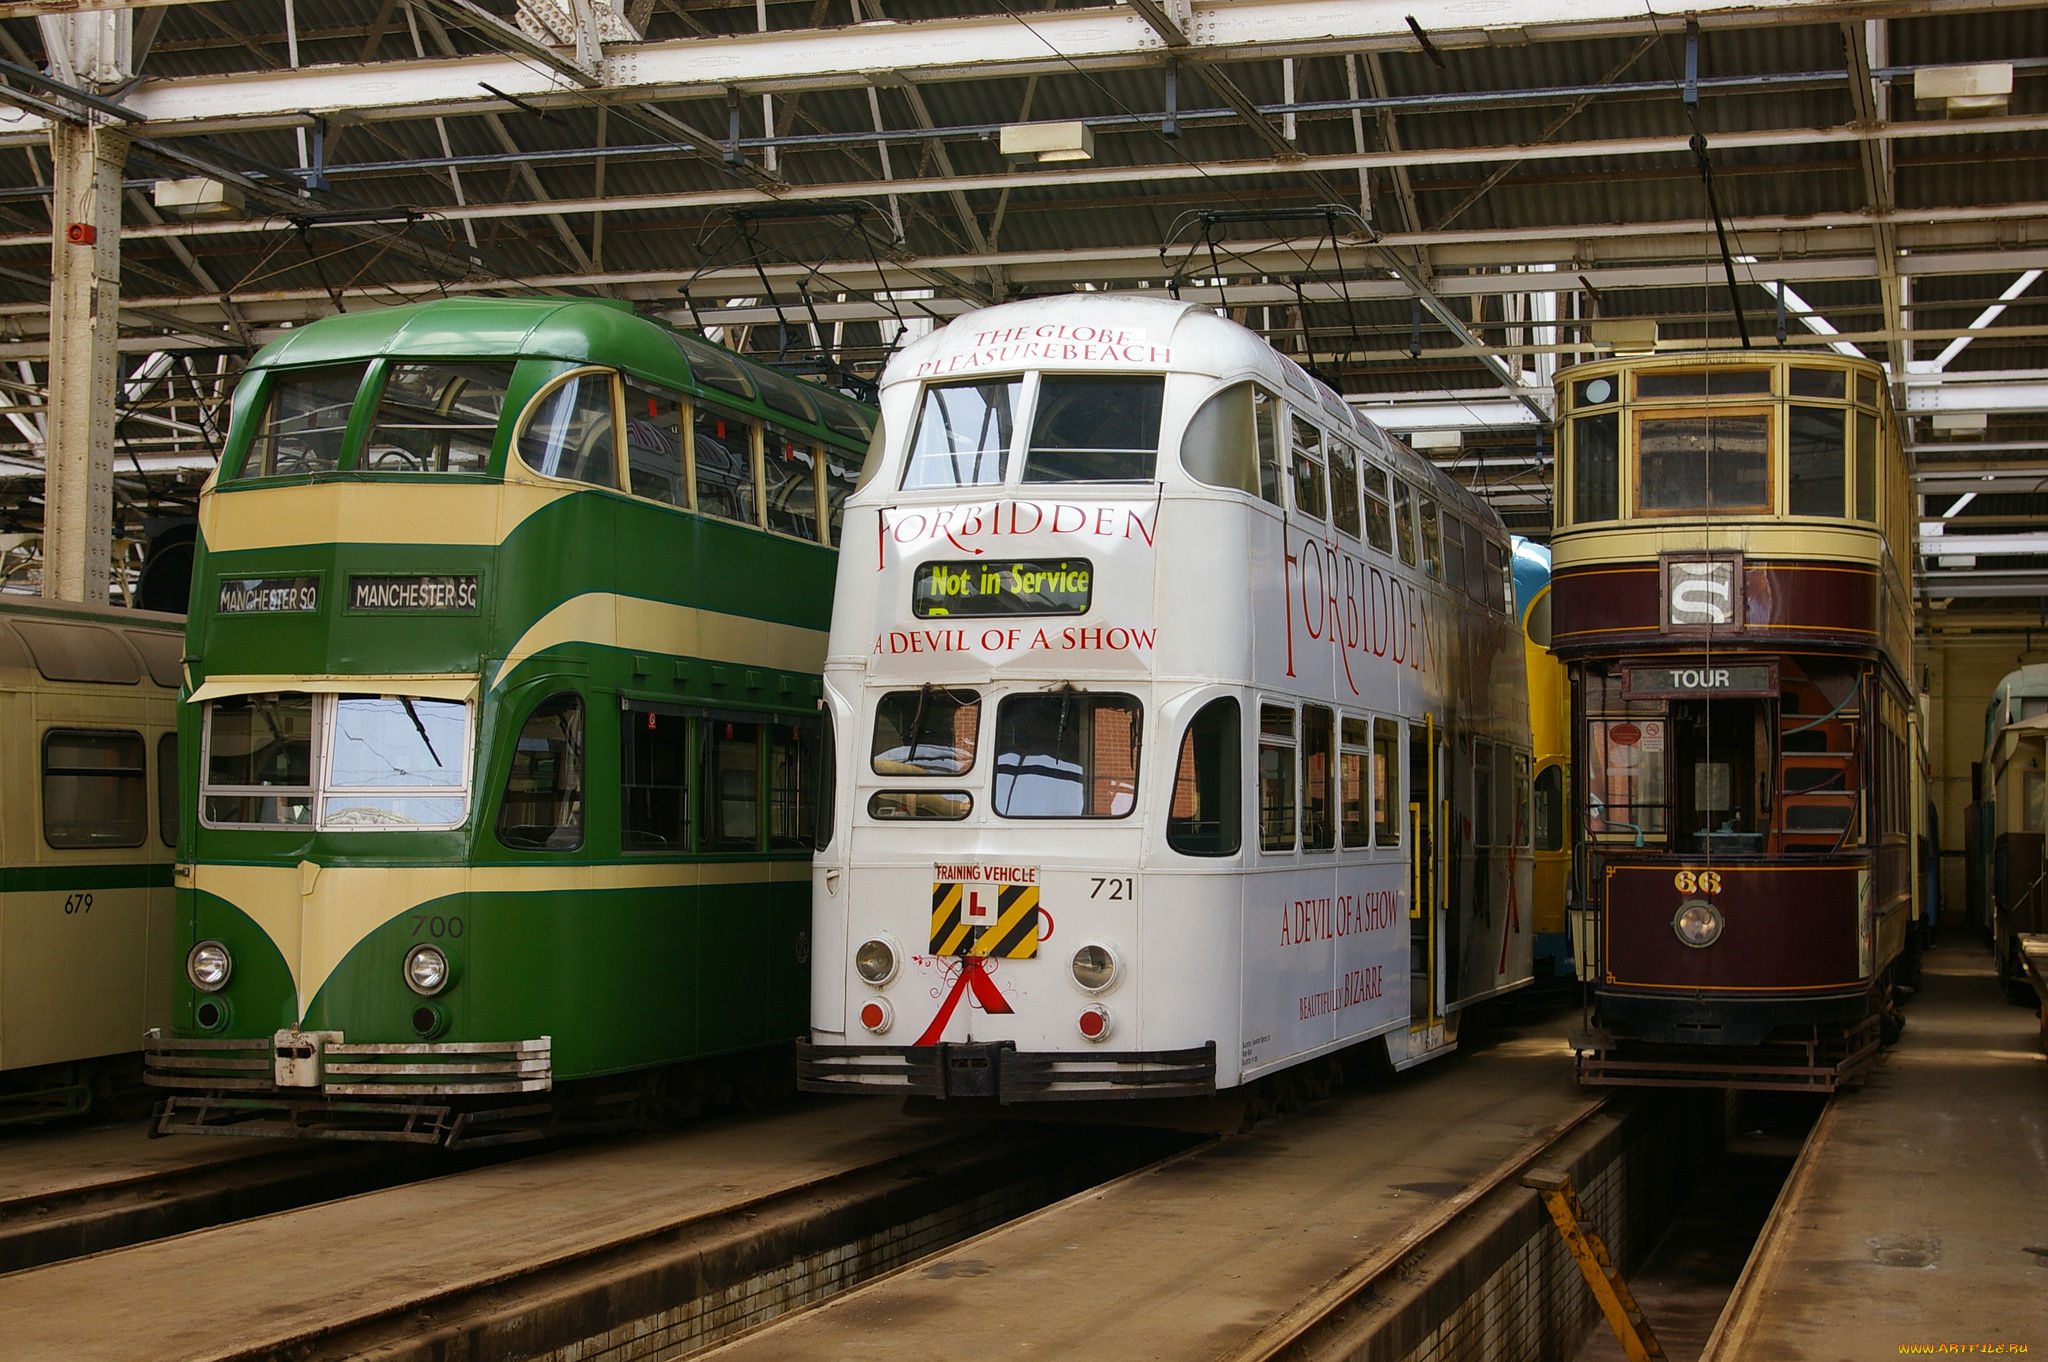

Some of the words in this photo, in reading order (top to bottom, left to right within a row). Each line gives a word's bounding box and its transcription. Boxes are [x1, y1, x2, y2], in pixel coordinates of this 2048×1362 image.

[975, 326, 1030, 346] THE
[1035, 325, 1132, 346] GLOBE
[876, 481, 1166, 572] FORBIDDEN
[931, 565, 971, 596] Not
[980, 564, 1000, 594] in
[1011, 562, 1090, 594] Service
[220, 588, 297, 612] MANCHESTER
[300, 586, 317, 609] SQ
[356, 584, 455, 607] MANCHESTER
[872, 634, 884, 655] A
[890, 629, 970, 654] DEVIL
[981, 629, 1028, 650] OF
[1028, 628, 1052, 650] A
[1062, 627, 1157, 650] SHOW
[1669, 669, 1730, 688] TOUR
[936, 865, 980, 880] TRAINING
[983, 866, 1035, 882] VEHICLE
[1674, 870, 1722, 895] 66
[1090, 878, 1133, 900] 721
[64, 893, 93, 914] 679
[969, 892, 986, 916] L
[411, 915, 464, 938] 700
[1280, 902, 1291, 947] A
[1294, 898, 1333, 944] DEVIL
[1336, 896, 1352, 937] OF
[1354, 894, 1362, 933] A
[1365, 890, 1398, 931] SHOW
[1299, 988, 1343, 1020] BEAUTIFULLY
[1344, 965, 1383, 1007] BIZARRE
